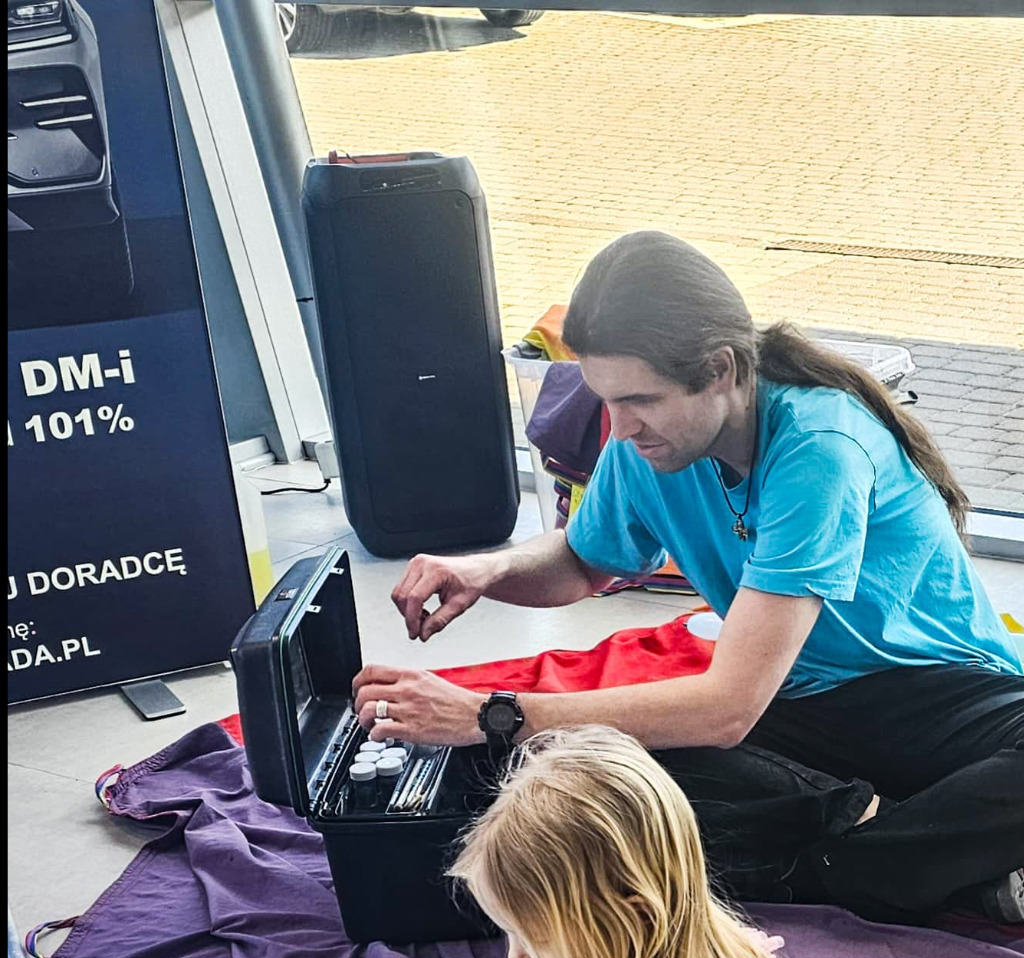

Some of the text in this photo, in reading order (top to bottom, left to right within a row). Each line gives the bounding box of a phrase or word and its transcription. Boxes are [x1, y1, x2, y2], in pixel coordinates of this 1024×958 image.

[20, 349, 136, 397] DM-i
[25, 403, 135, 443] 101%
[27, 547, 188, 595] DORADCĘ
[8, 636, 102, 672] DA.PL
